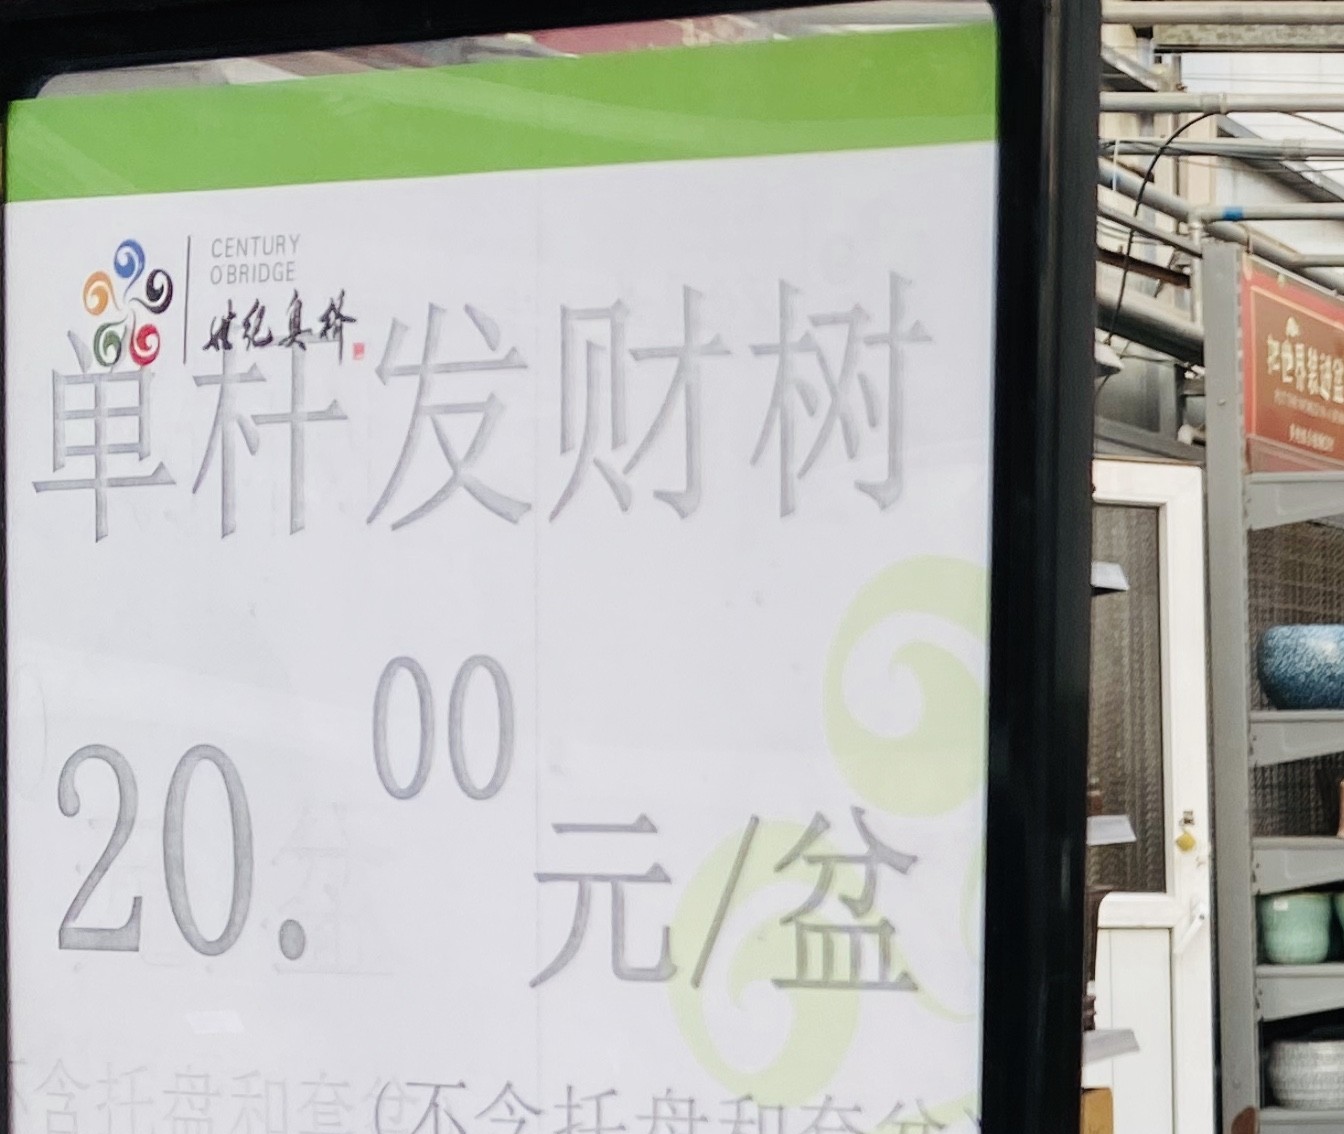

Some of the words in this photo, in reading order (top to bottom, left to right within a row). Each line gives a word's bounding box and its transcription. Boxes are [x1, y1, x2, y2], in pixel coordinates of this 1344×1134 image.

[211, 234, 301, 259] CENTURY
[373, 654, 515, 801] 00
[528, 806, 920, 992] 元/盆
